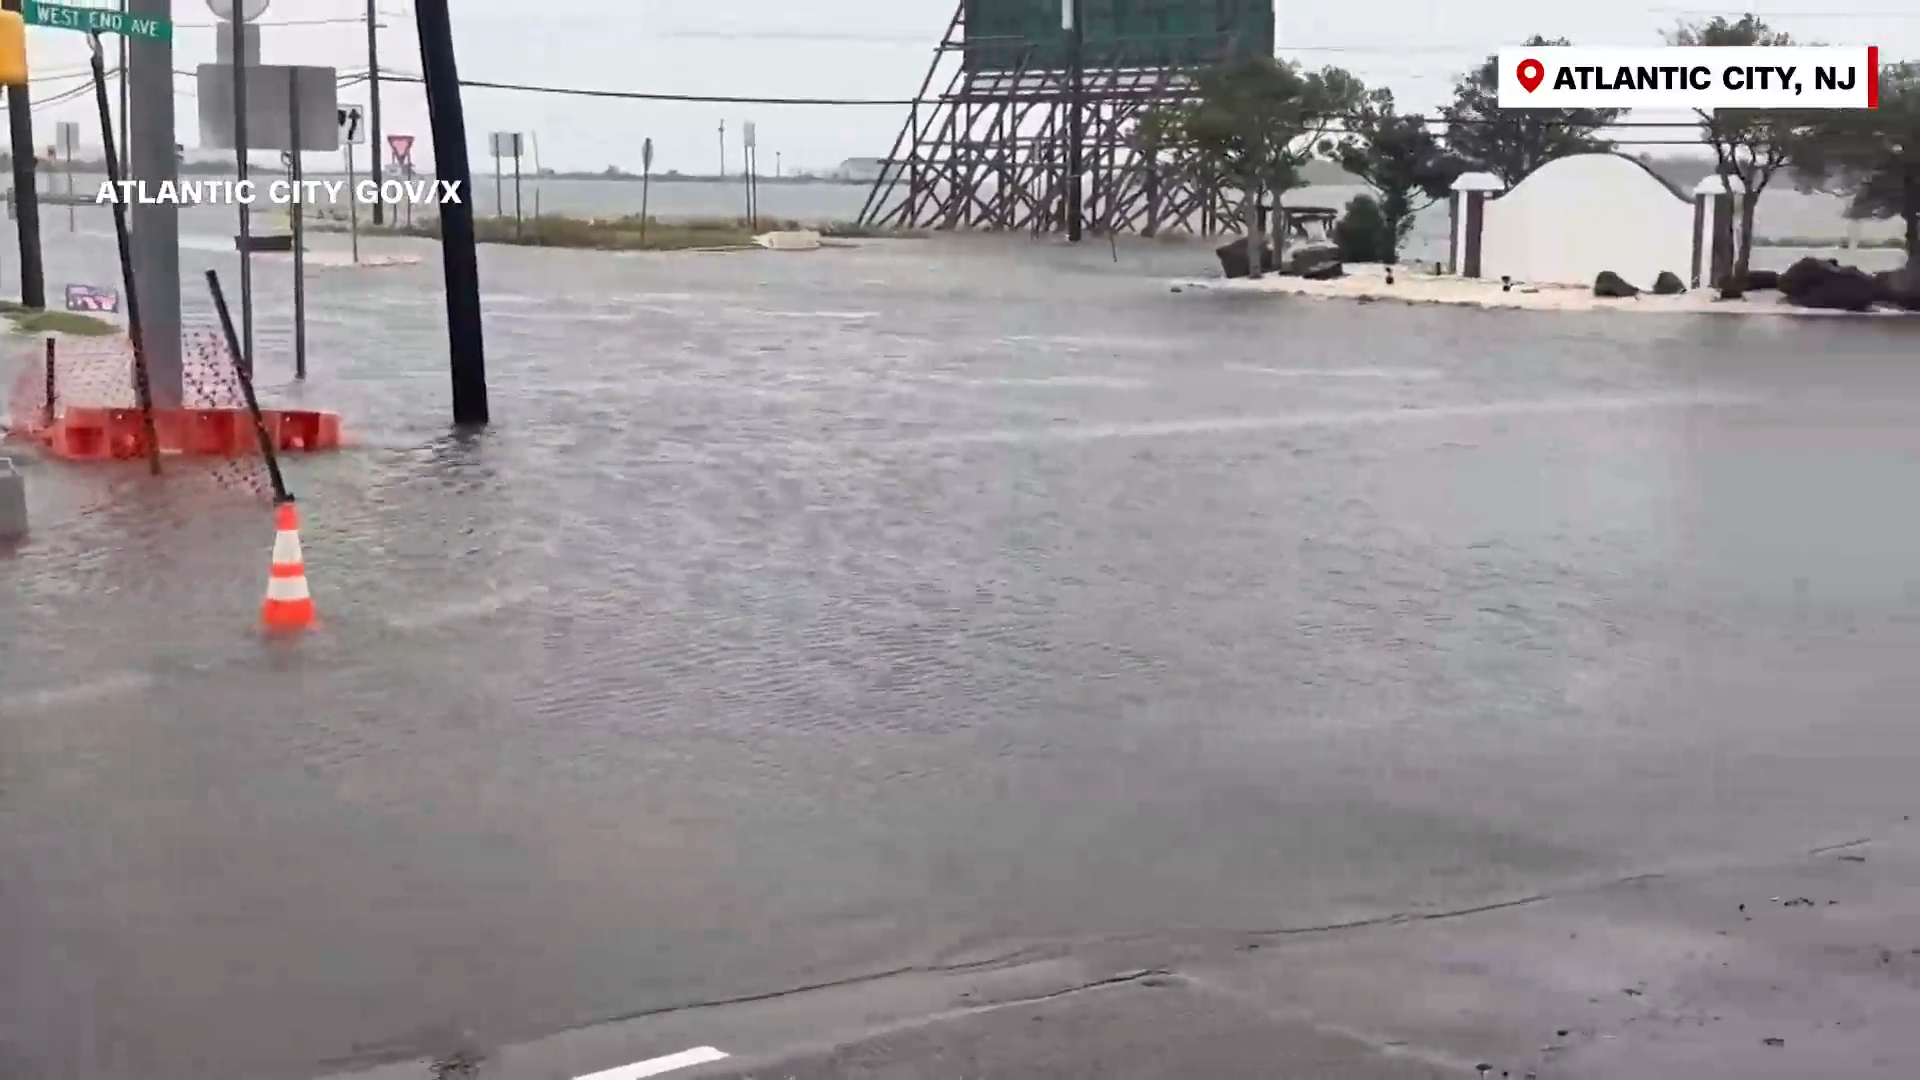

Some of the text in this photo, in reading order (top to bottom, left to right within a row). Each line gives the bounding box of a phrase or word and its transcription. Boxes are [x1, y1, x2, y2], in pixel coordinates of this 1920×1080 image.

[37, 7, 159, 38] WEST END AVE
